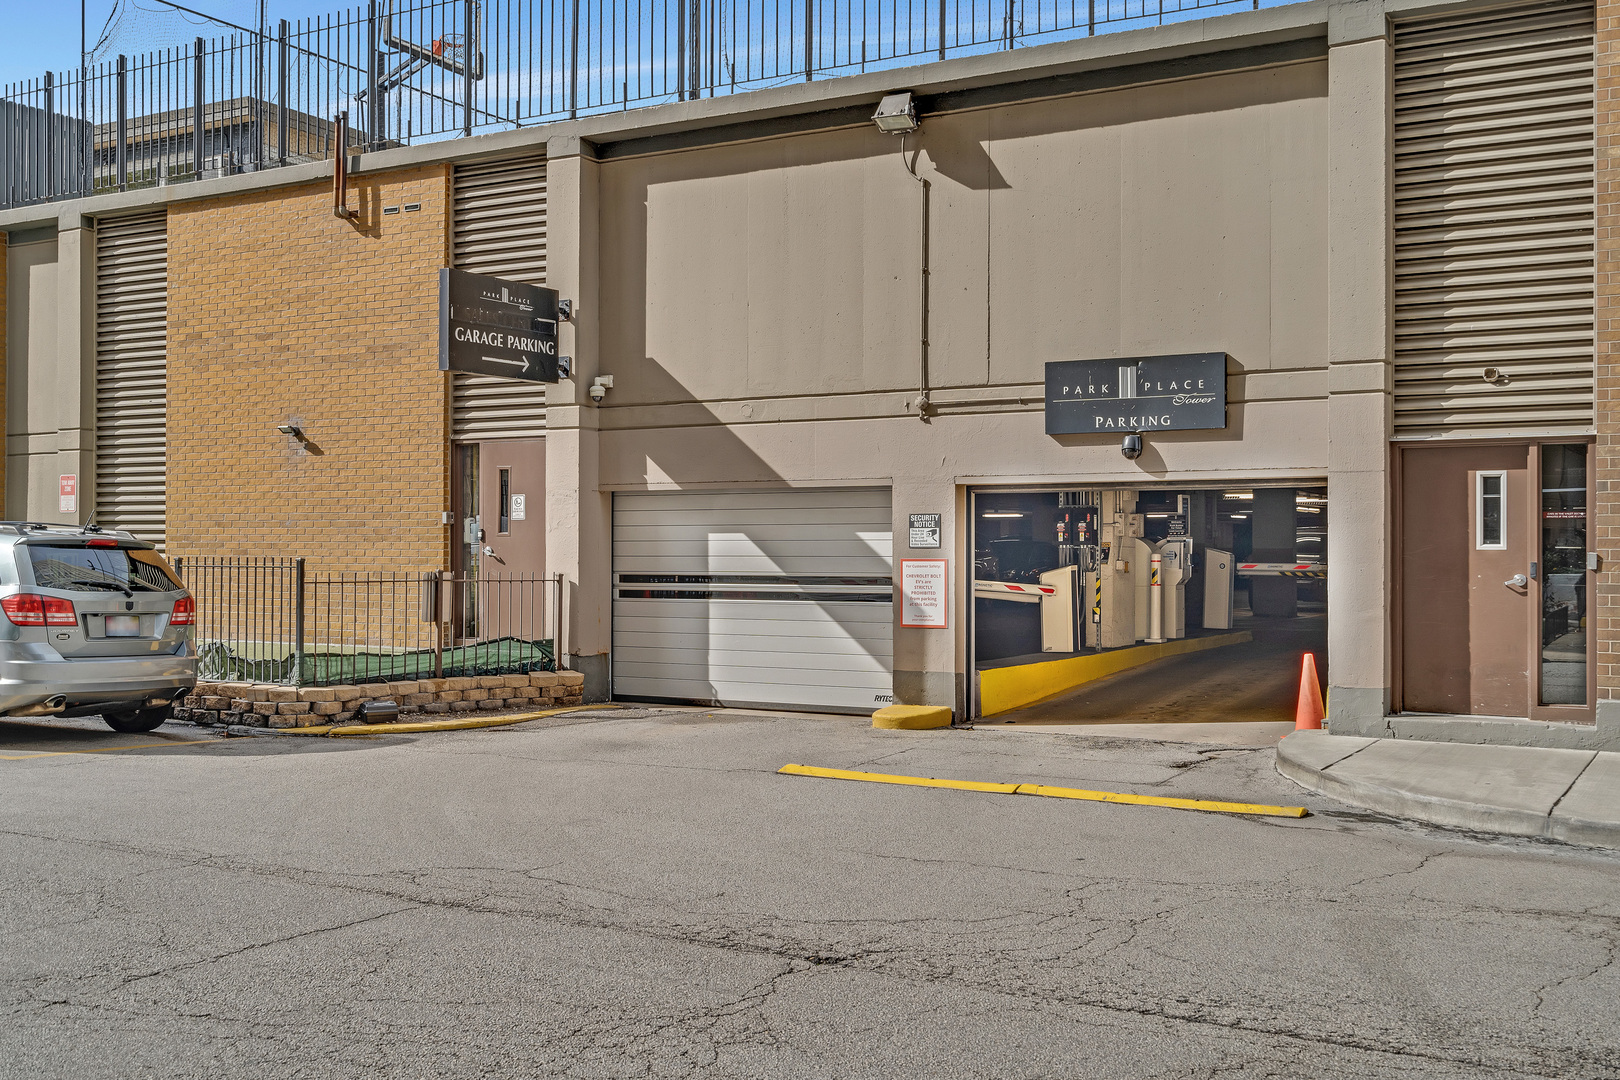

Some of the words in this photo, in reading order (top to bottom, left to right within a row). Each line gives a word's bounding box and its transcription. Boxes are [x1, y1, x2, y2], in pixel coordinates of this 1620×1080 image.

[483, 291, 500, 299] PARK
[510, 296, 530, 305] PLACE
[454, 327, 504, 348] GARAGE
[507, 335, 555, 355] PARKING
[1063, 384, 1109, 395] PARK
[1144, 379, 1205, 391] PLACE
[1172, 392, 1216, 406] Tower
[1095, 415, 1171, 428] PARKING
